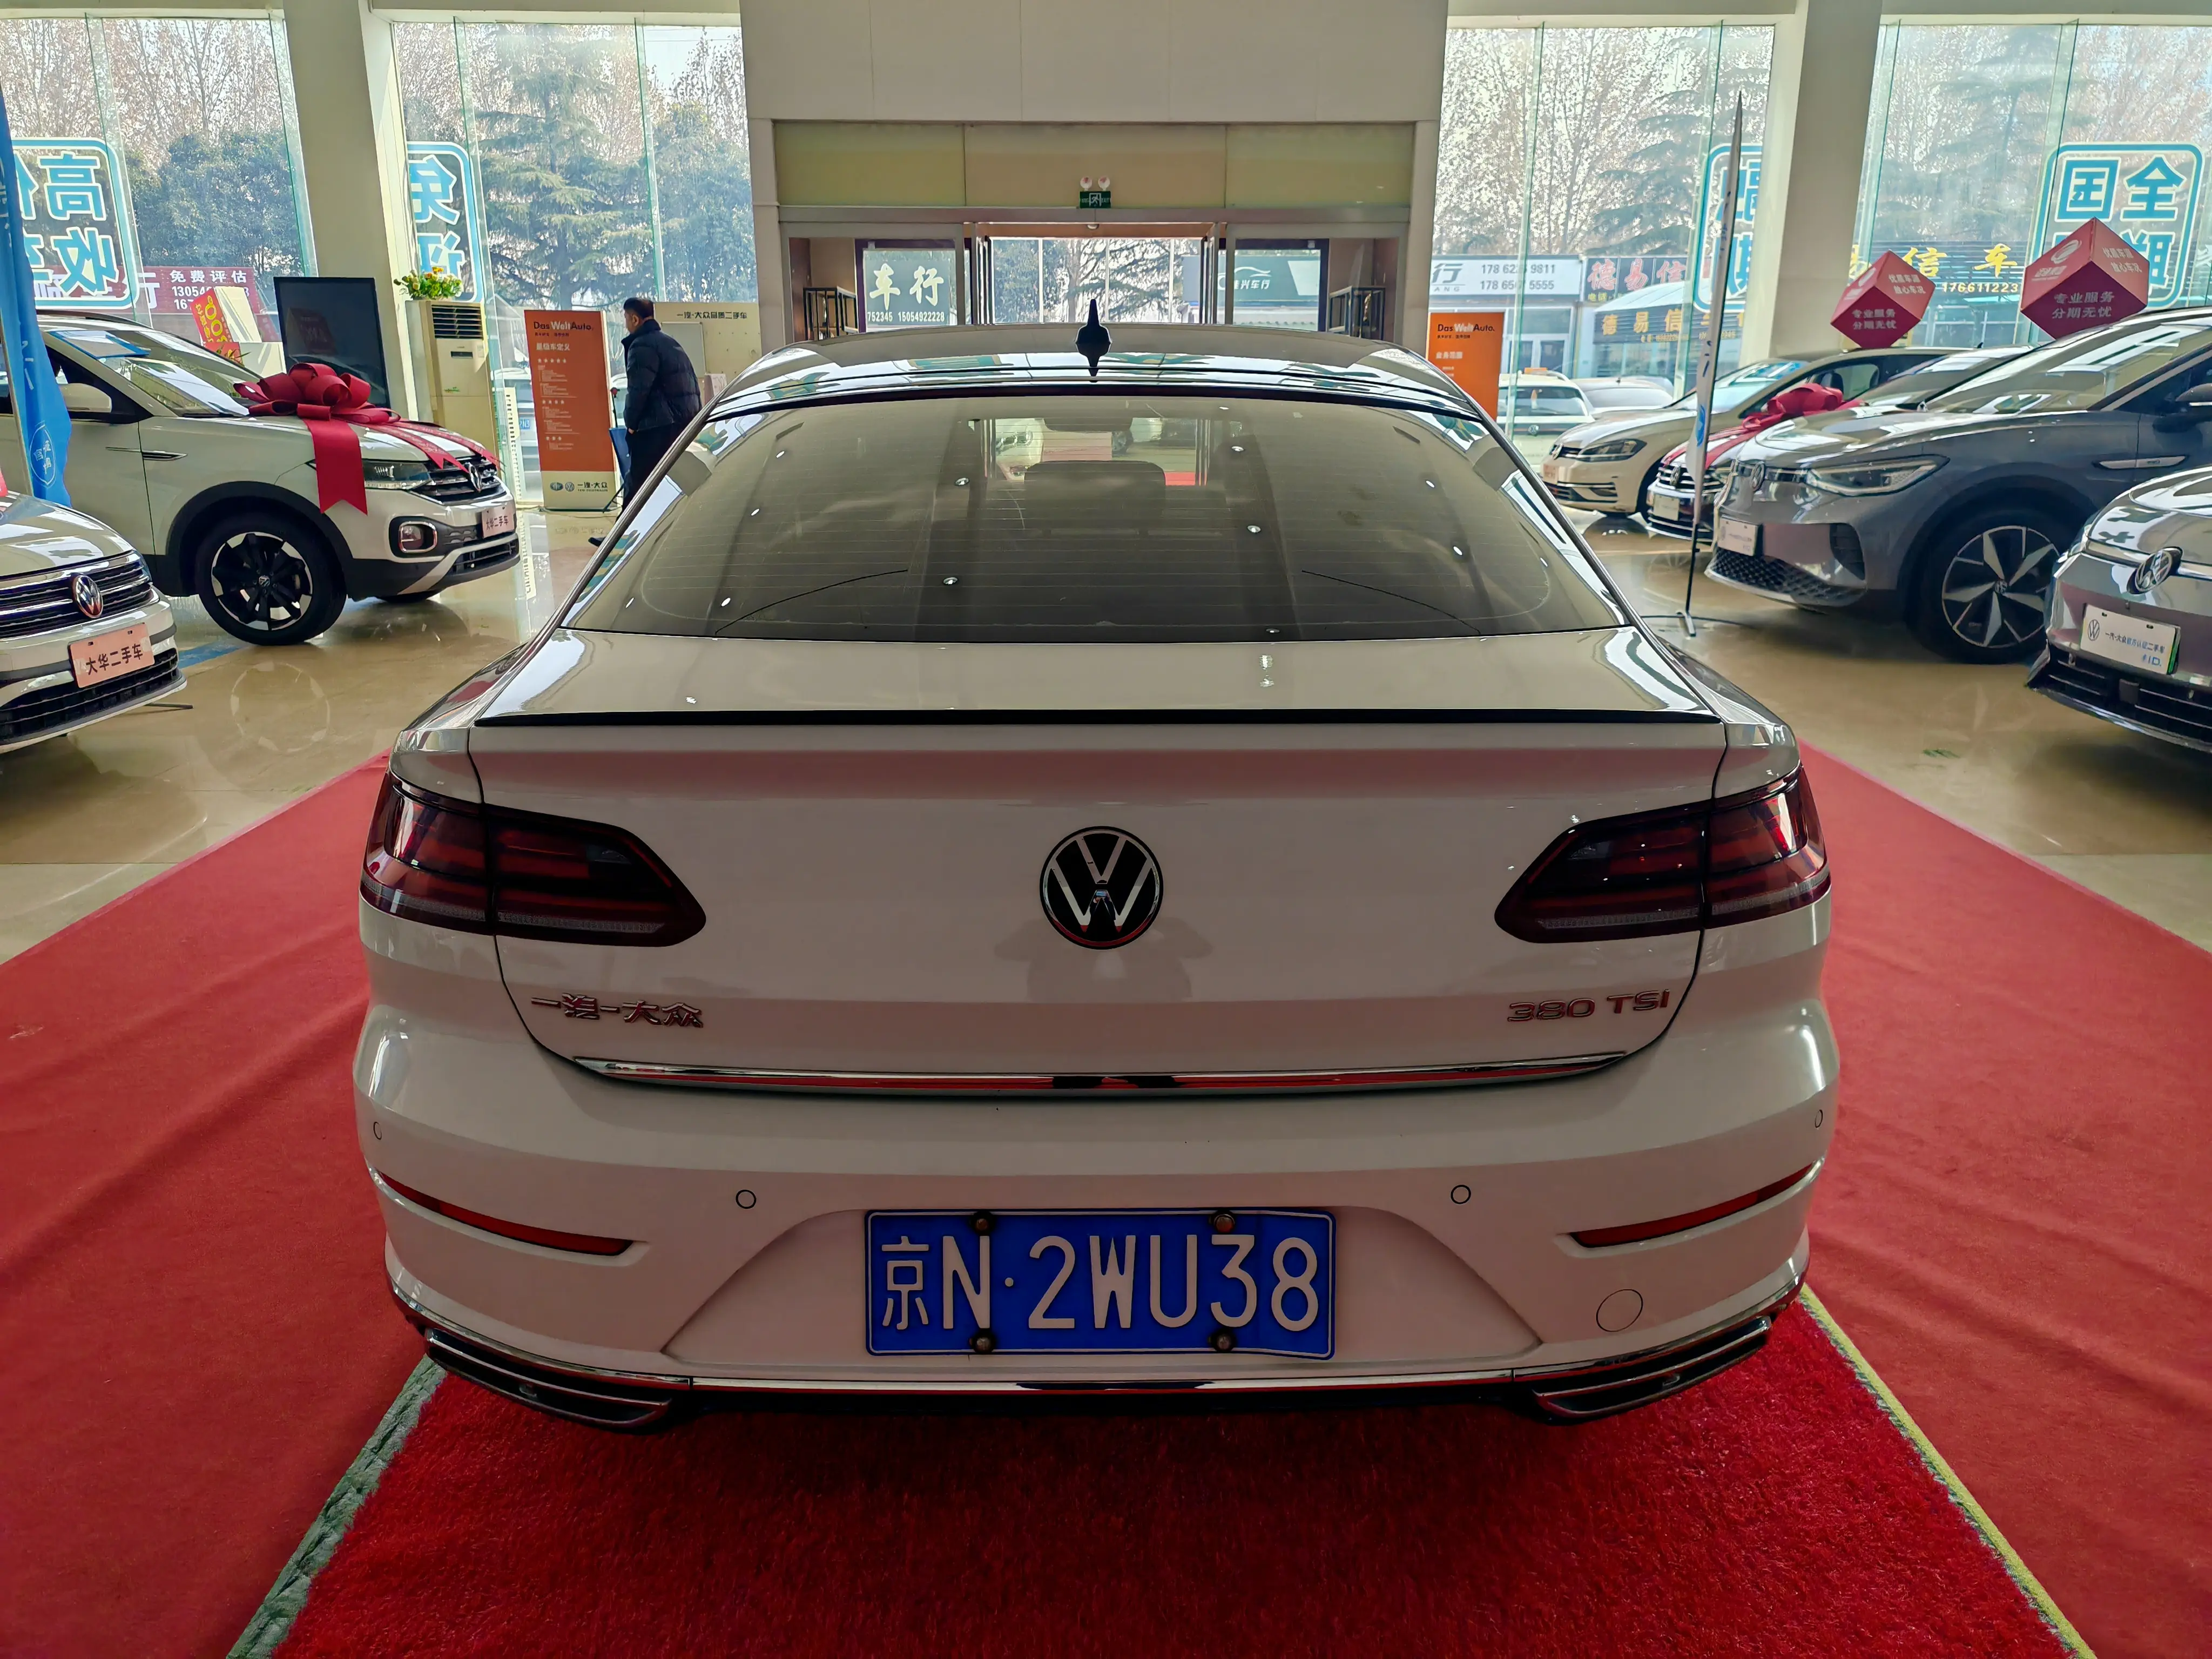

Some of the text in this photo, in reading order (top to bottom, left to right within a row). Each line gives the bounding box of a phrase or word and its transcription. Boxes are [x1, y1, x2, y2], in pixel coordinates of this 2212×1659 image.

[170, 269, 247, 284] 免费评估
[869, 263, 944, 311] 车行
[2052, 306, 2113, 319] 分期无忧
[86, 643, 143, 675] 大华二手车
[1507, 989, 1670, 1022] 380 TSI
